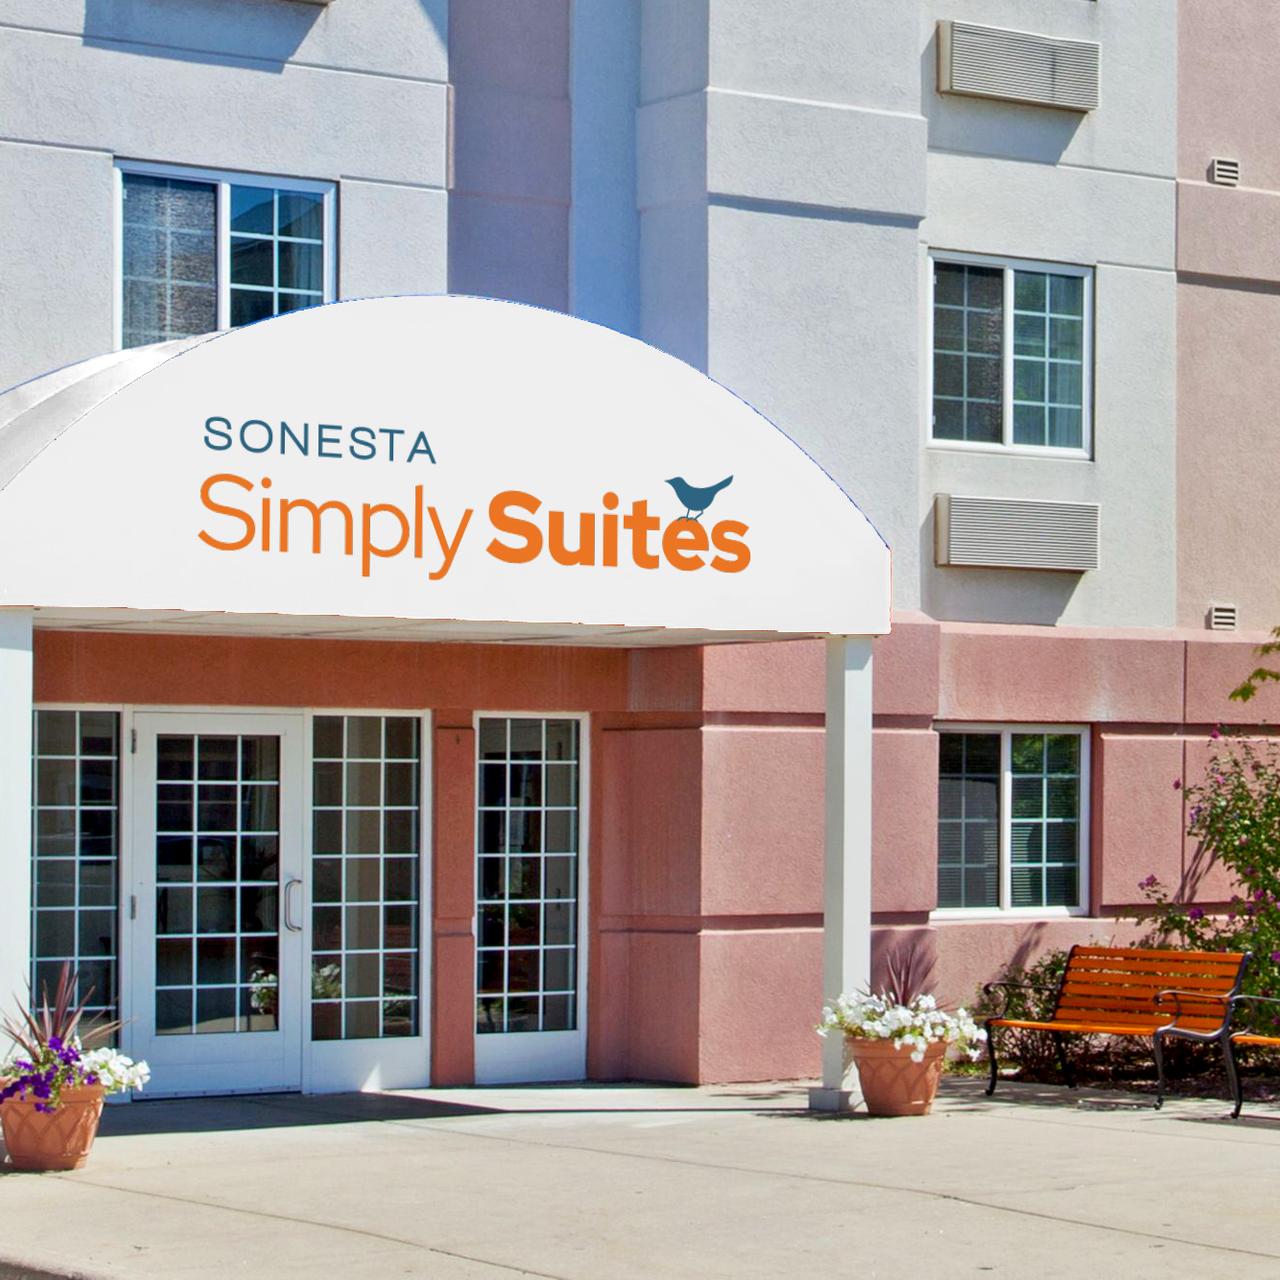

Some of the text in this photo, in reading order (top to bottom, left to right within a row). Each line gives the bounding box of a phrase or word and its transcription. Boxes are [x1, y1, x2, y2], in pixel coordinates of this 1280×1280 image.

[204, 416, 437, 464] SONESTA
[198, 473, 751, 581] Simply Suites
